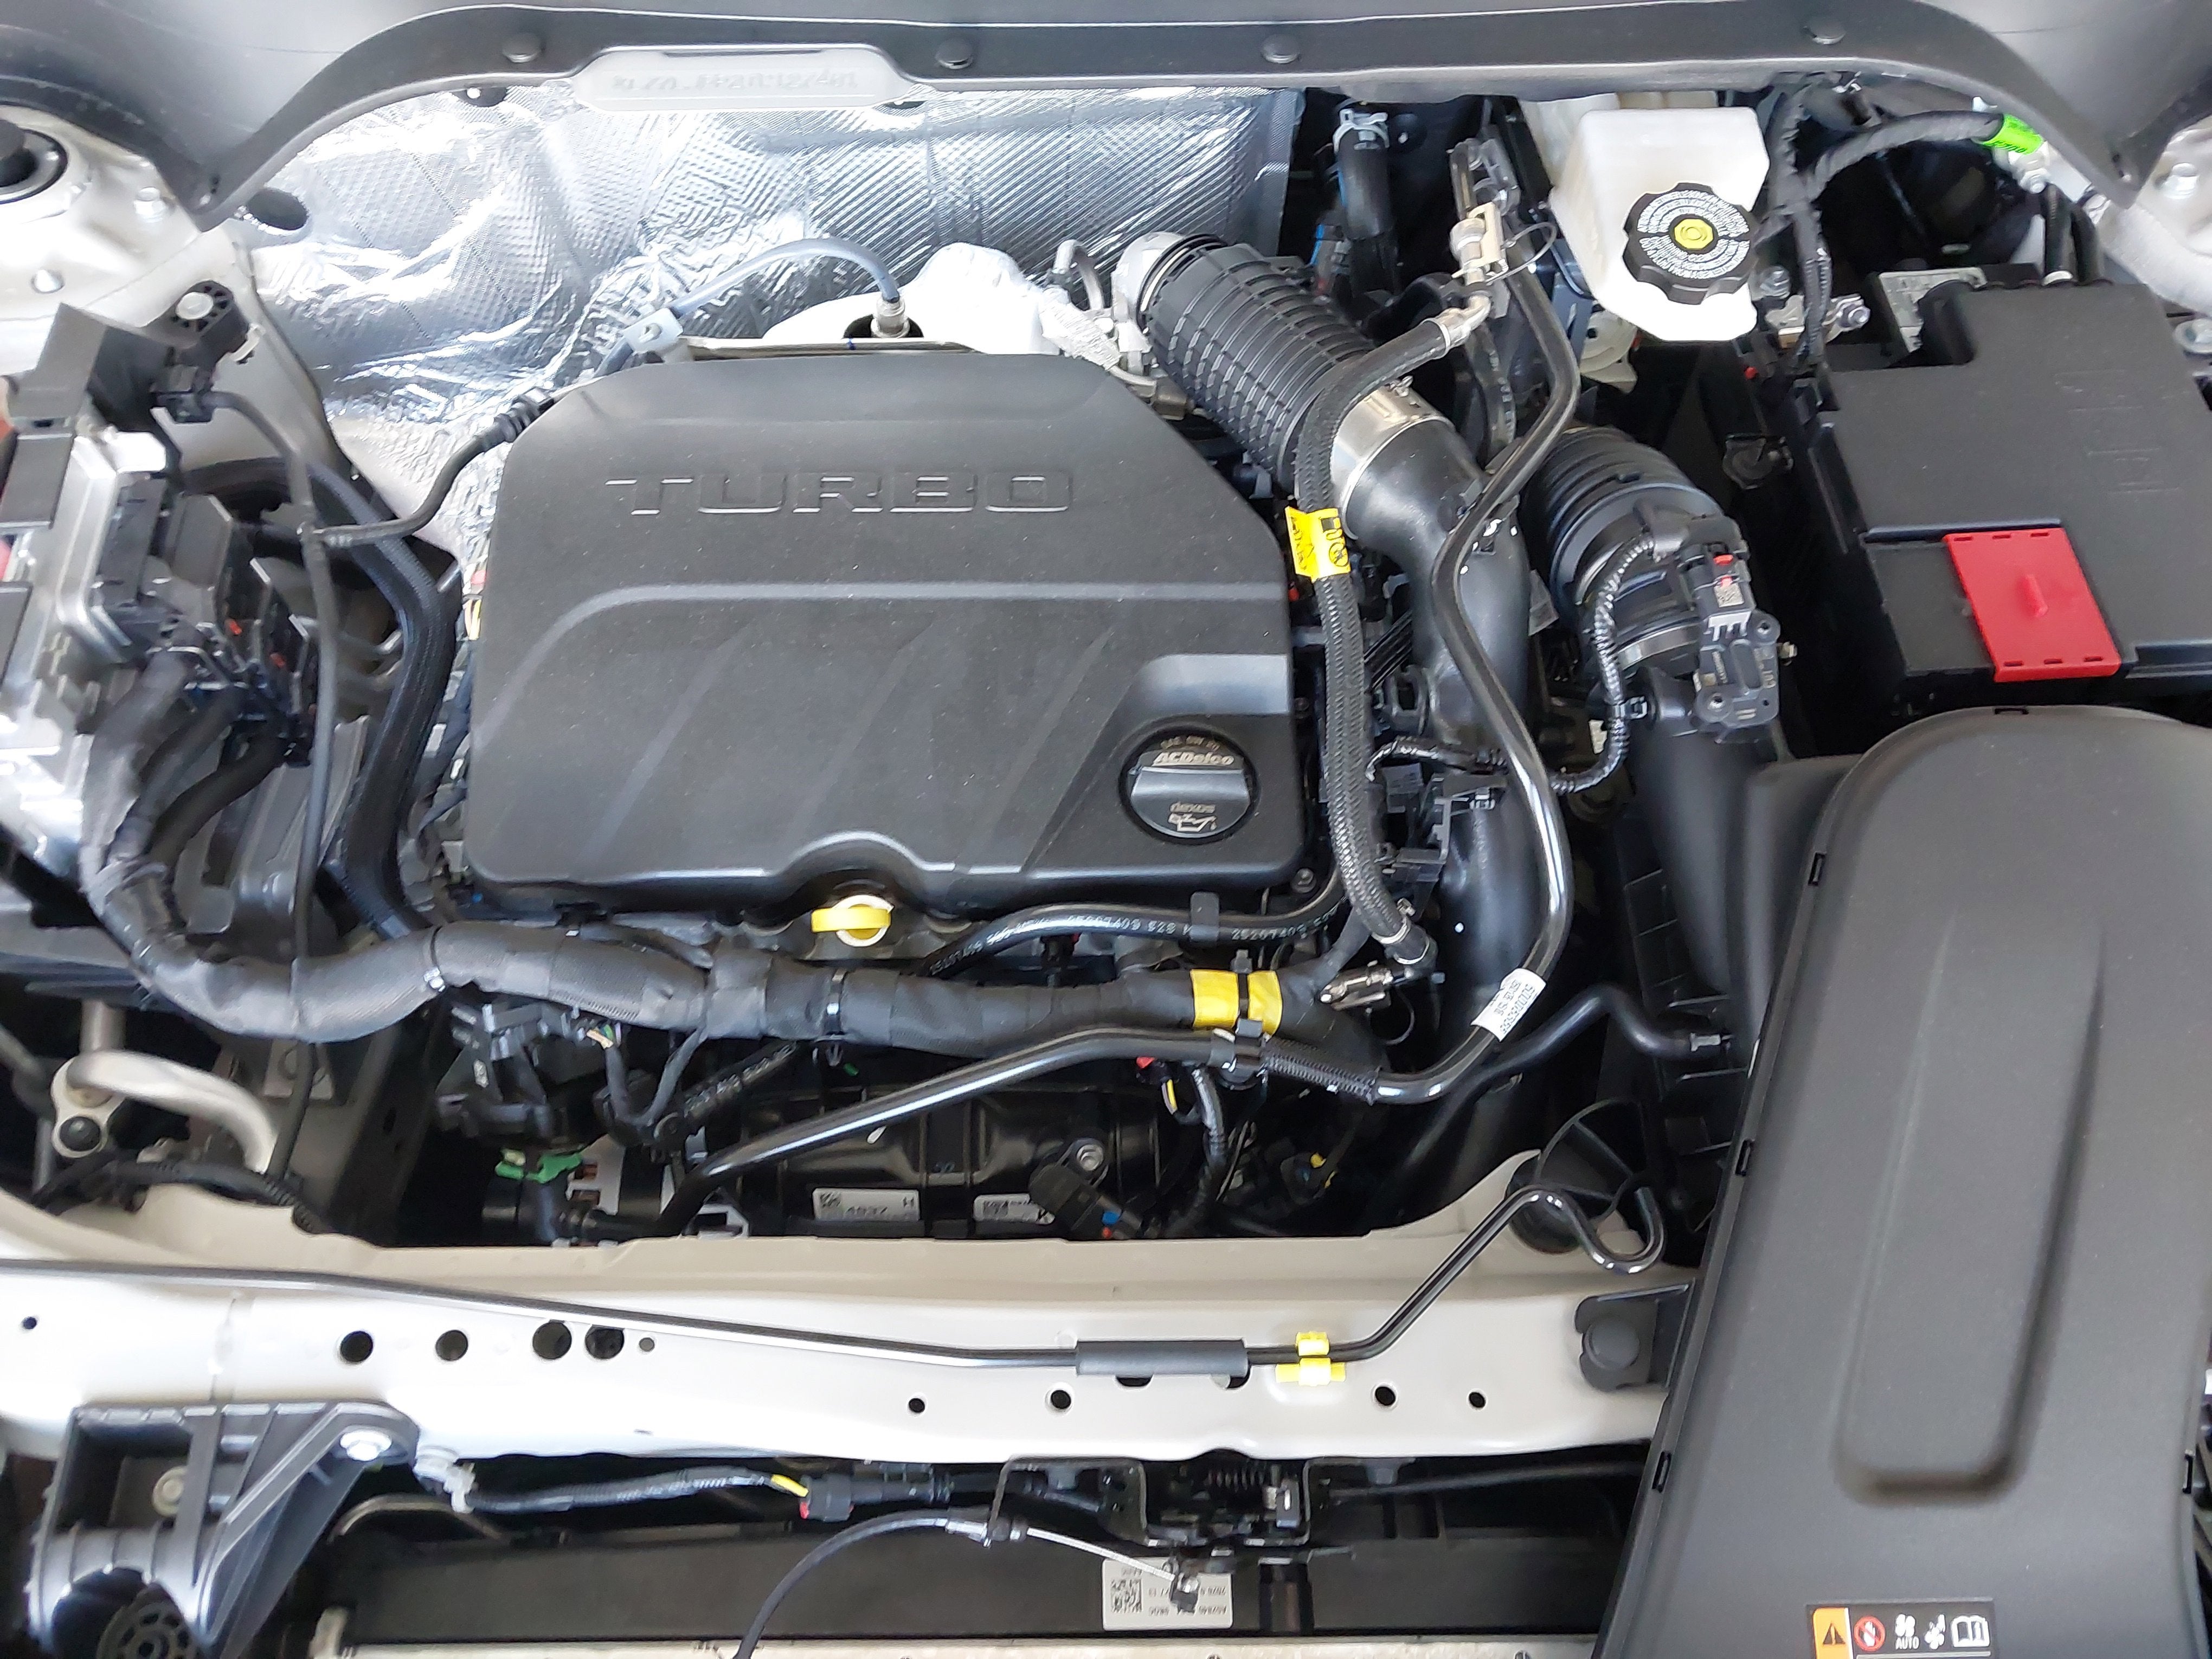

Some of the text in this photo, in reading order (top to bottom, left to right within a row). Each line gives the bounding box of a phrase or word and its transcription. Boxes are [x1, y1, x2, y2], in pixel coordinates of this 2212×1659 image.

[605, 471, 1073, 515] TURBO
[1153, 751, 1235, 766] ACDelco
[1895, 1636, 1920, 1650] AUTO
